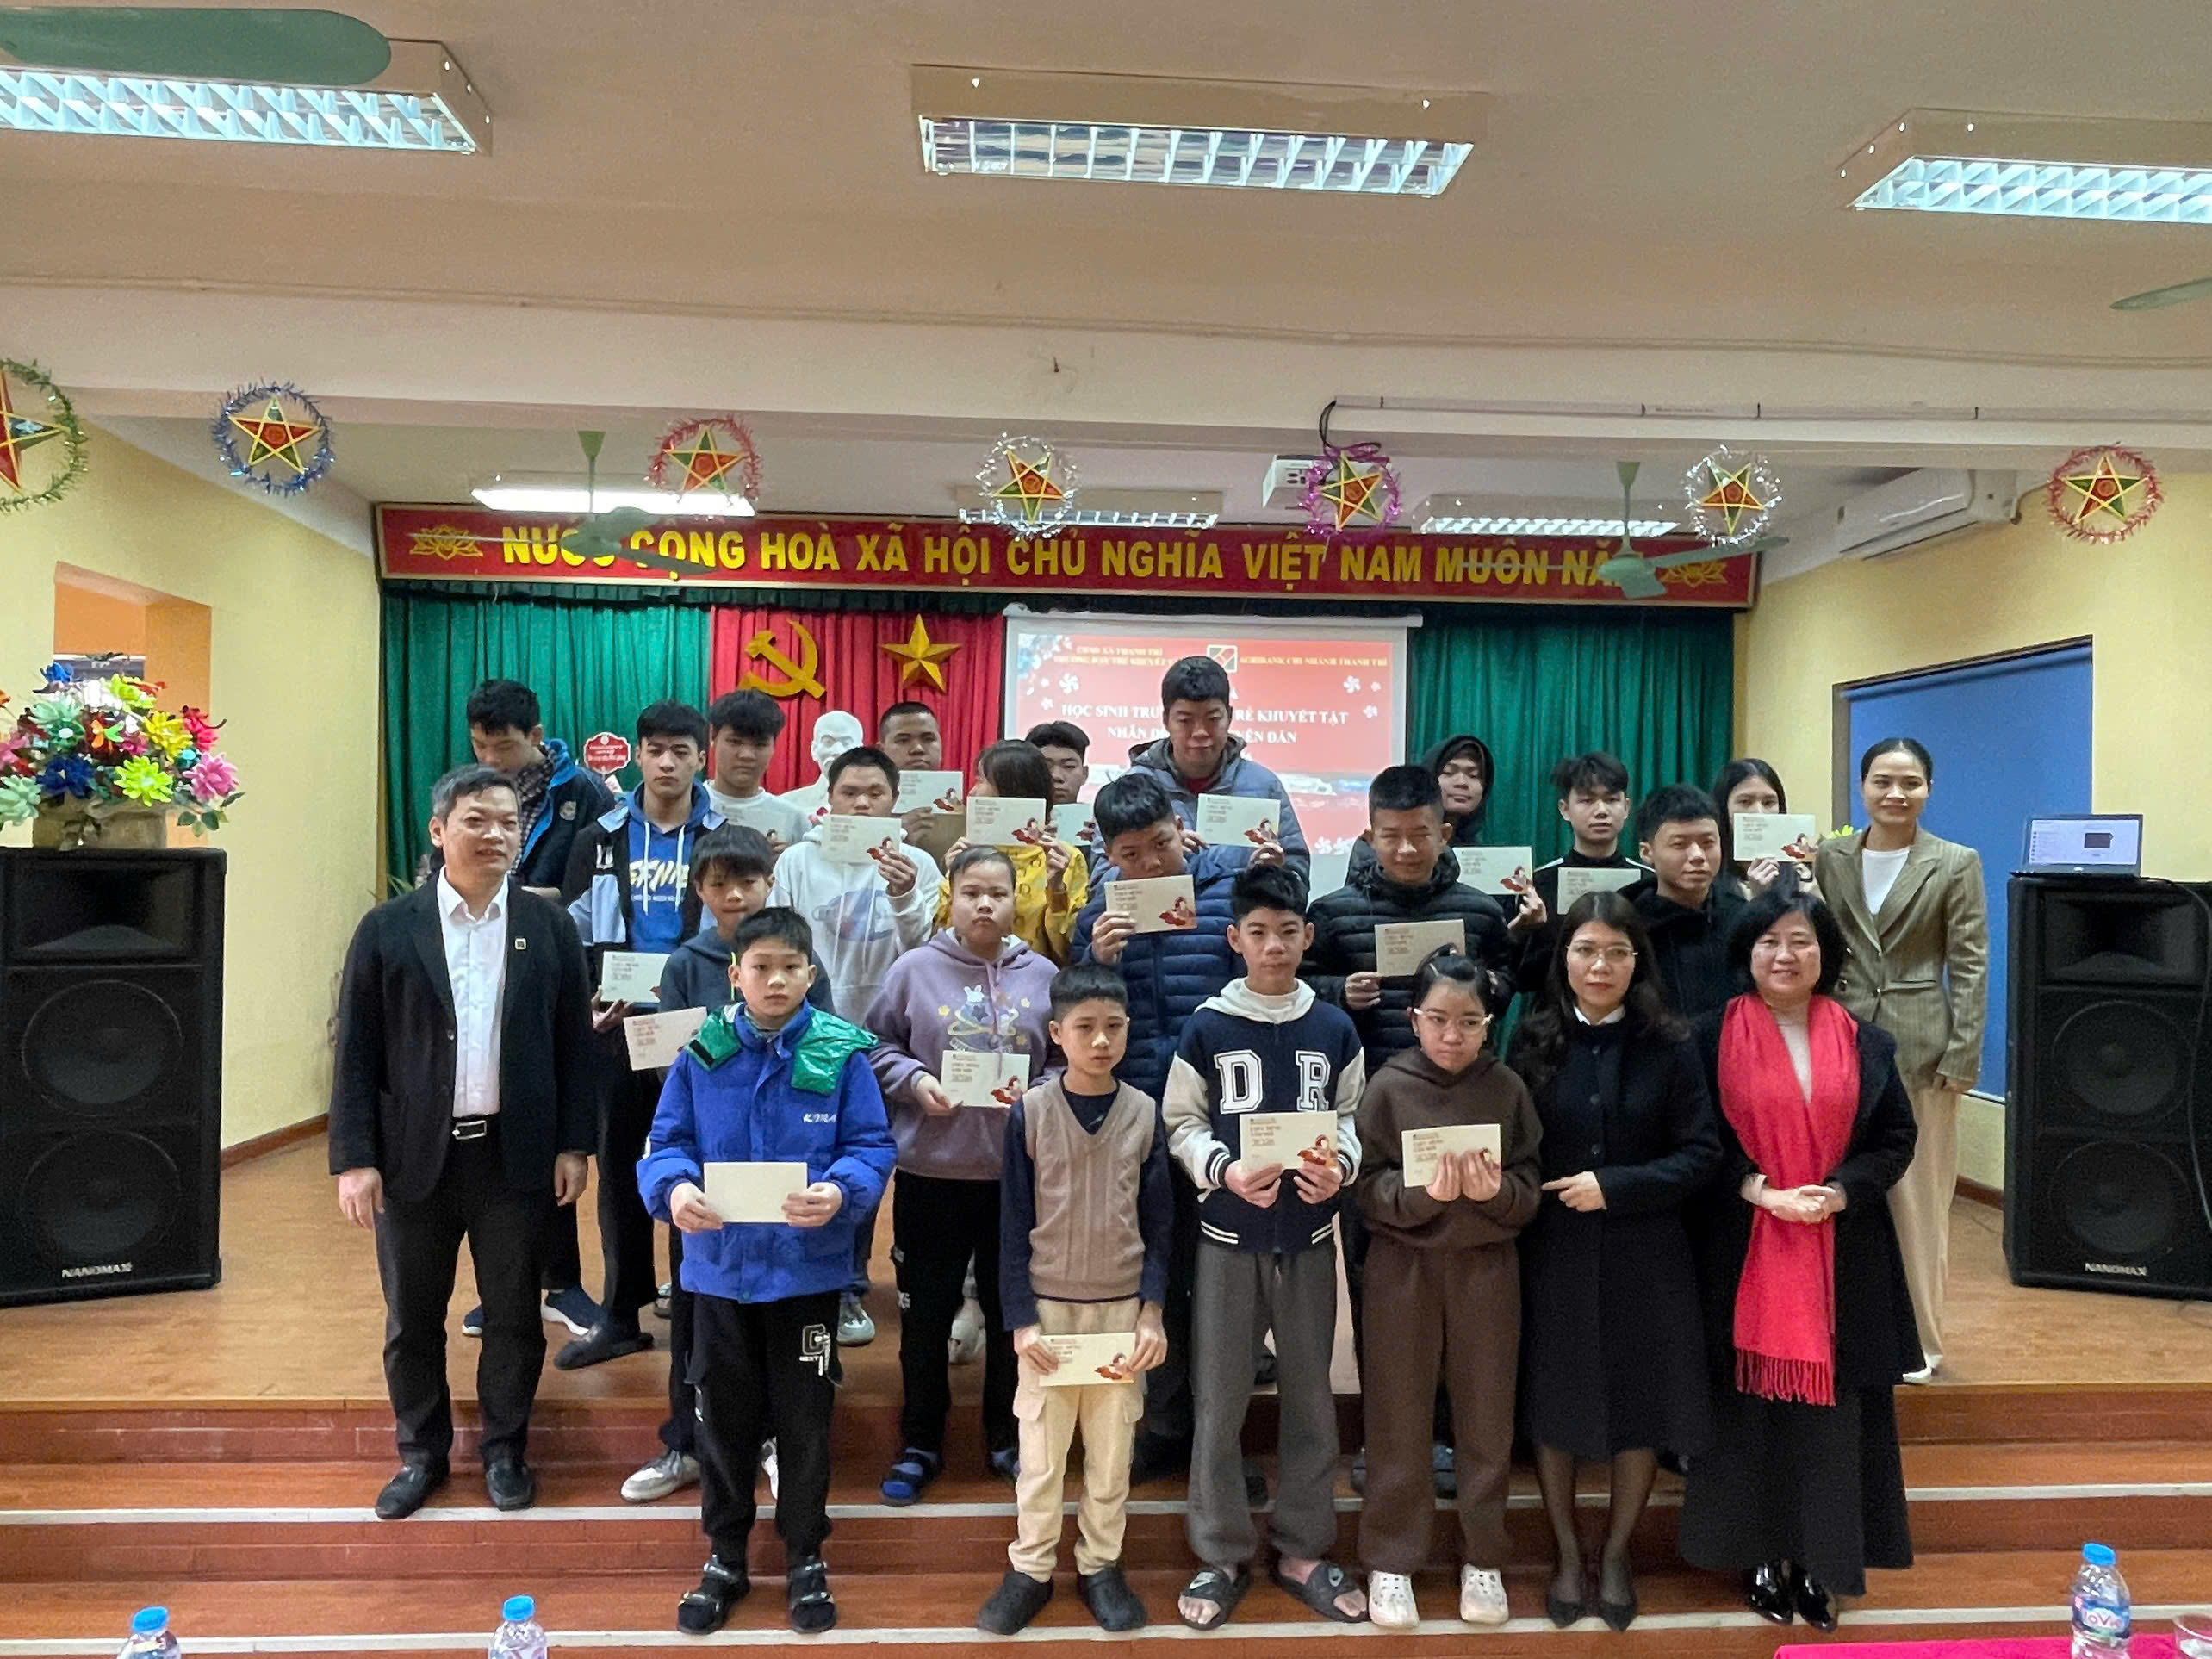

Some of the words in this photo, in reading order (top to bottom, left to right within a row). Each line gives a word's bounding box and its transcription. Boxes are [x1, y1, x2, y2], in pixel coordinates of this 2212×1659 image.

[760, 521, 841, 571] HOÀ
[855, 521, 910, 572] XÃ
[923, 524, 991, 587] HỘI
[1006, 527, 1087, 577] CHỦ
[1101, 528, 1224, 580] NGHĨA
[1241, 531, 1325, 591] VIỆT
[1339, 544, 1423, 582] NAM
[1434, 537, 1549, 585] MUÔN
[1061, 704, 1093, 718] HỌC
[1095, 705, 1128, 718] SINH
[1258, 708, 1317, 723] KHUYẾT
[1213, 1049, 1264, 1115] D
[1295, 1050, 1331, 1113] R
